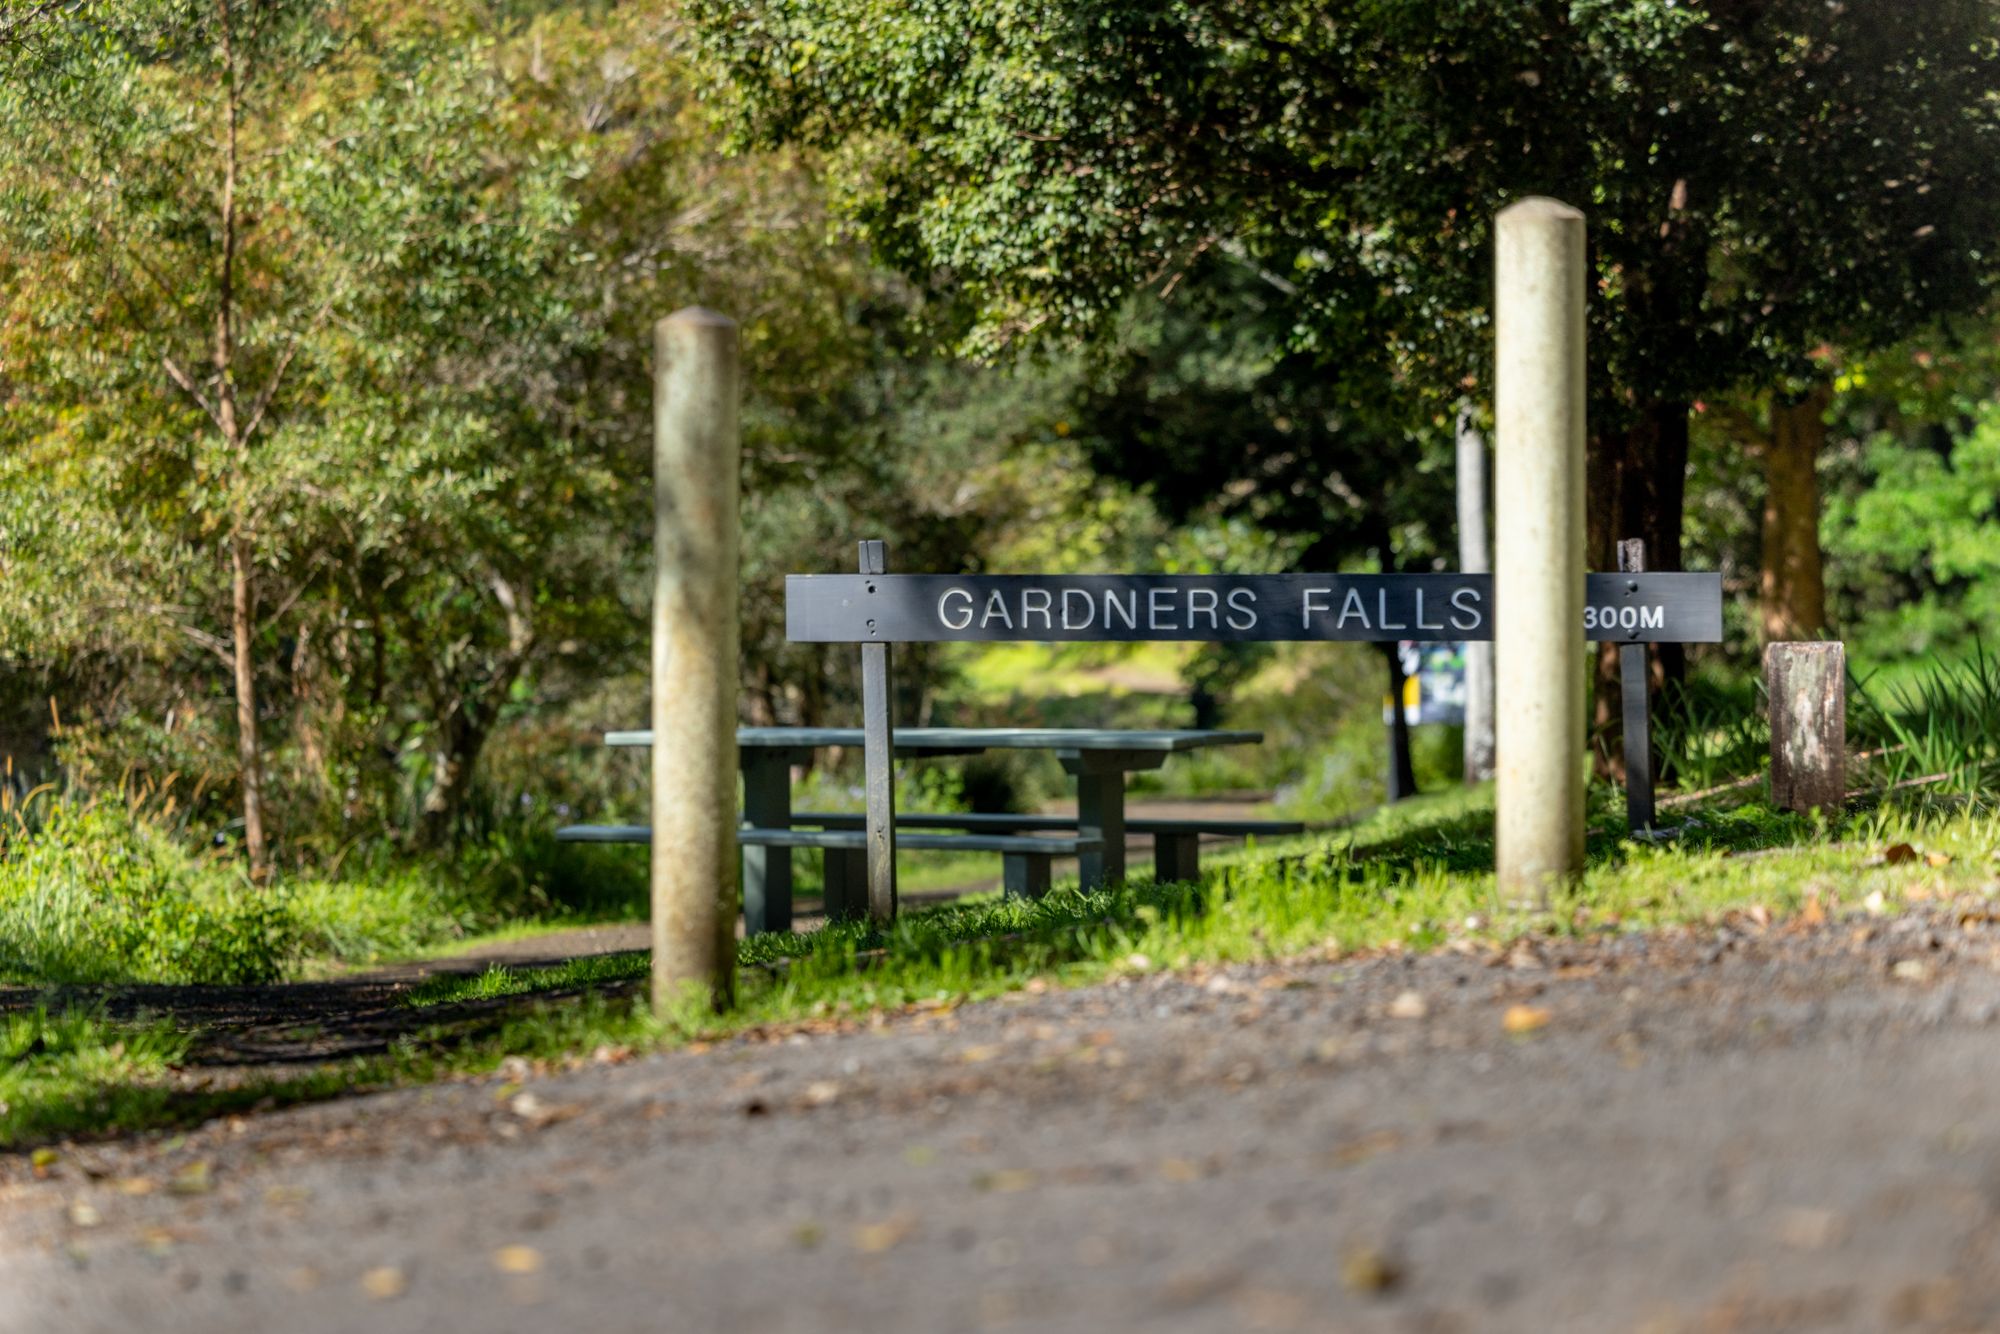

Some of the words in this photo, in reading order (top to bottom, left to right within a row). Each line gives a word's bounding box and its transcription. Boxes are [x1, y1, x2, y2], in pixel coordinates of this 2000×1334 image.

[937, 587, 1257, 629] GARDNERS
[1302, 587, 1482, 630] FALLS
[1583, 605, 1664, 629] 300M
